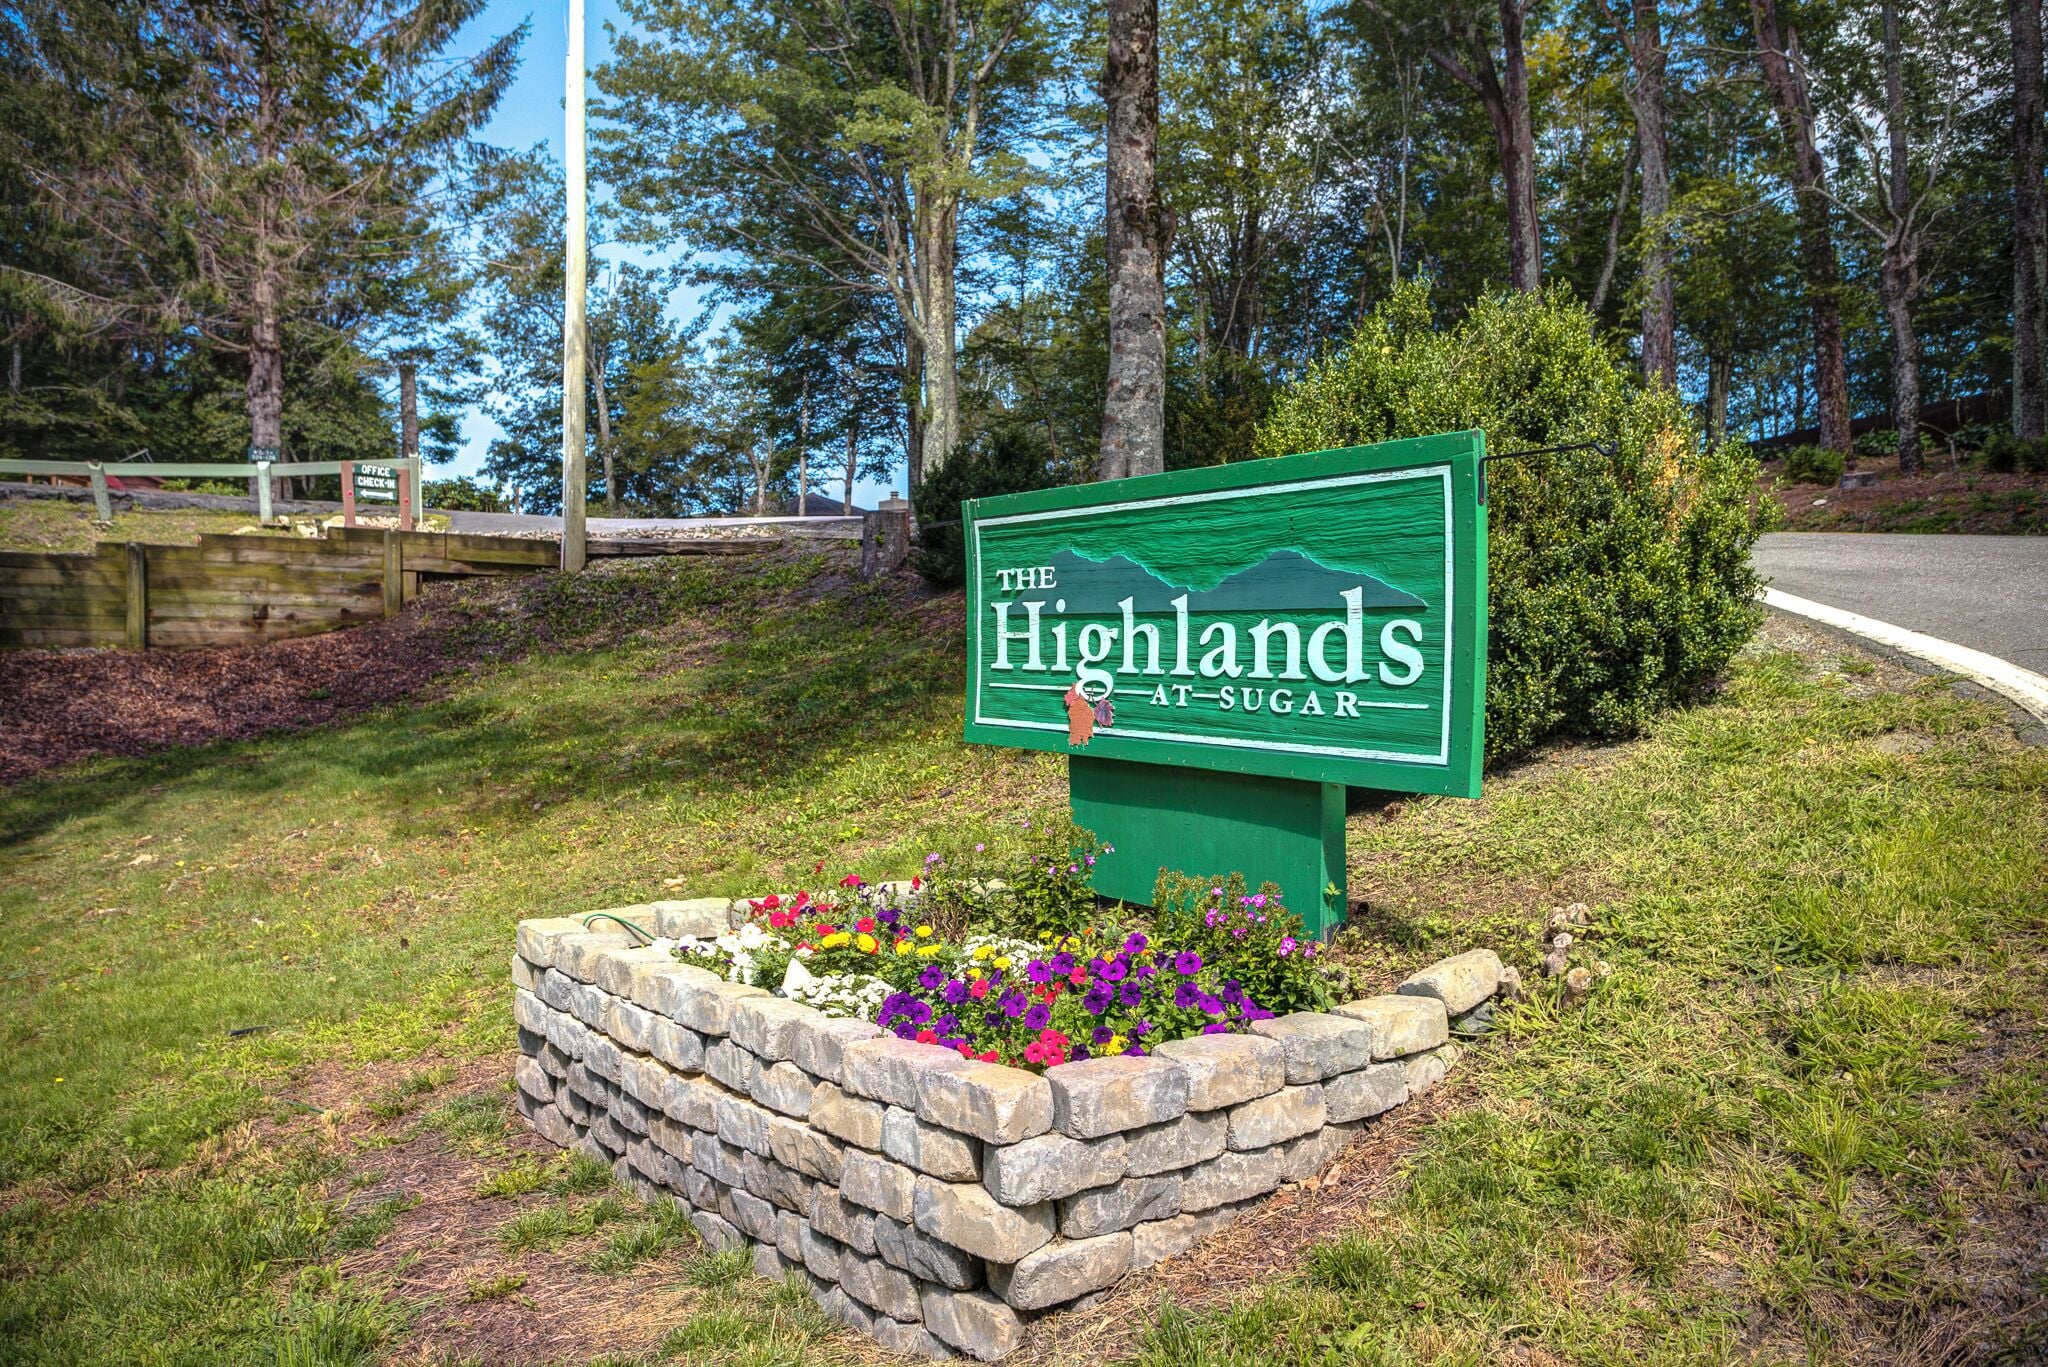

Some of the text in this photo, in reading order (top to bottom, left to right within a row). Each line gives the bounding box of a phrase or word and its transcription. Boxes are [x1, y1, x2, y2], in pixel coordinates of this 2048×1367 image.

[357, 476, 395, 488] CHECK-IN
[361, 464, 391, 477] OFFICE
[996, 566, 1057, 591] THE
[990, 585, 1425, 702] Highlands
[1151, 683, 1361, 718] AT SUGAR
